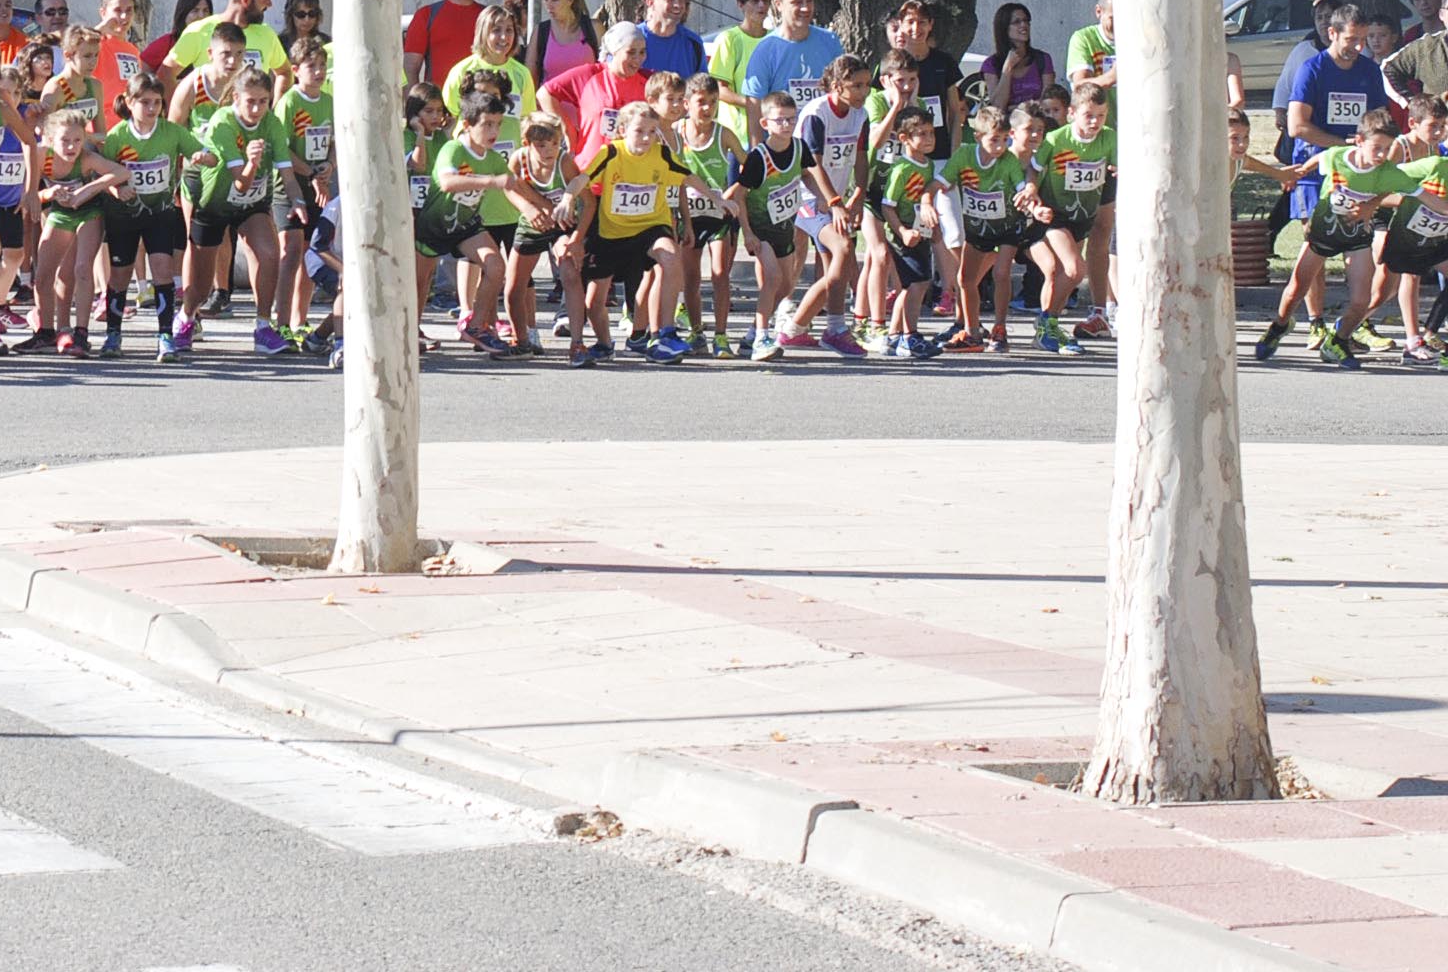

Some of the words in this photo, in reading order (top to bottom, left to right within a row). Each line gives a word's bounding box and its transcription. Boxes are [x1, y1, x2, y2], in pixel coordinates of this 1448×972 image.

[122, 61, 139, 74] 31
[1334, 102, 1361, 116] 350
[135, 169, 164, 185] 361
[1073, 169, 1101, 184] 340
[620, 193, 650, 206] 140
[774, 189, 798, 213] 367
[968, 197, 997, 212] 364
[1418, 216, 1448, 232] 347
